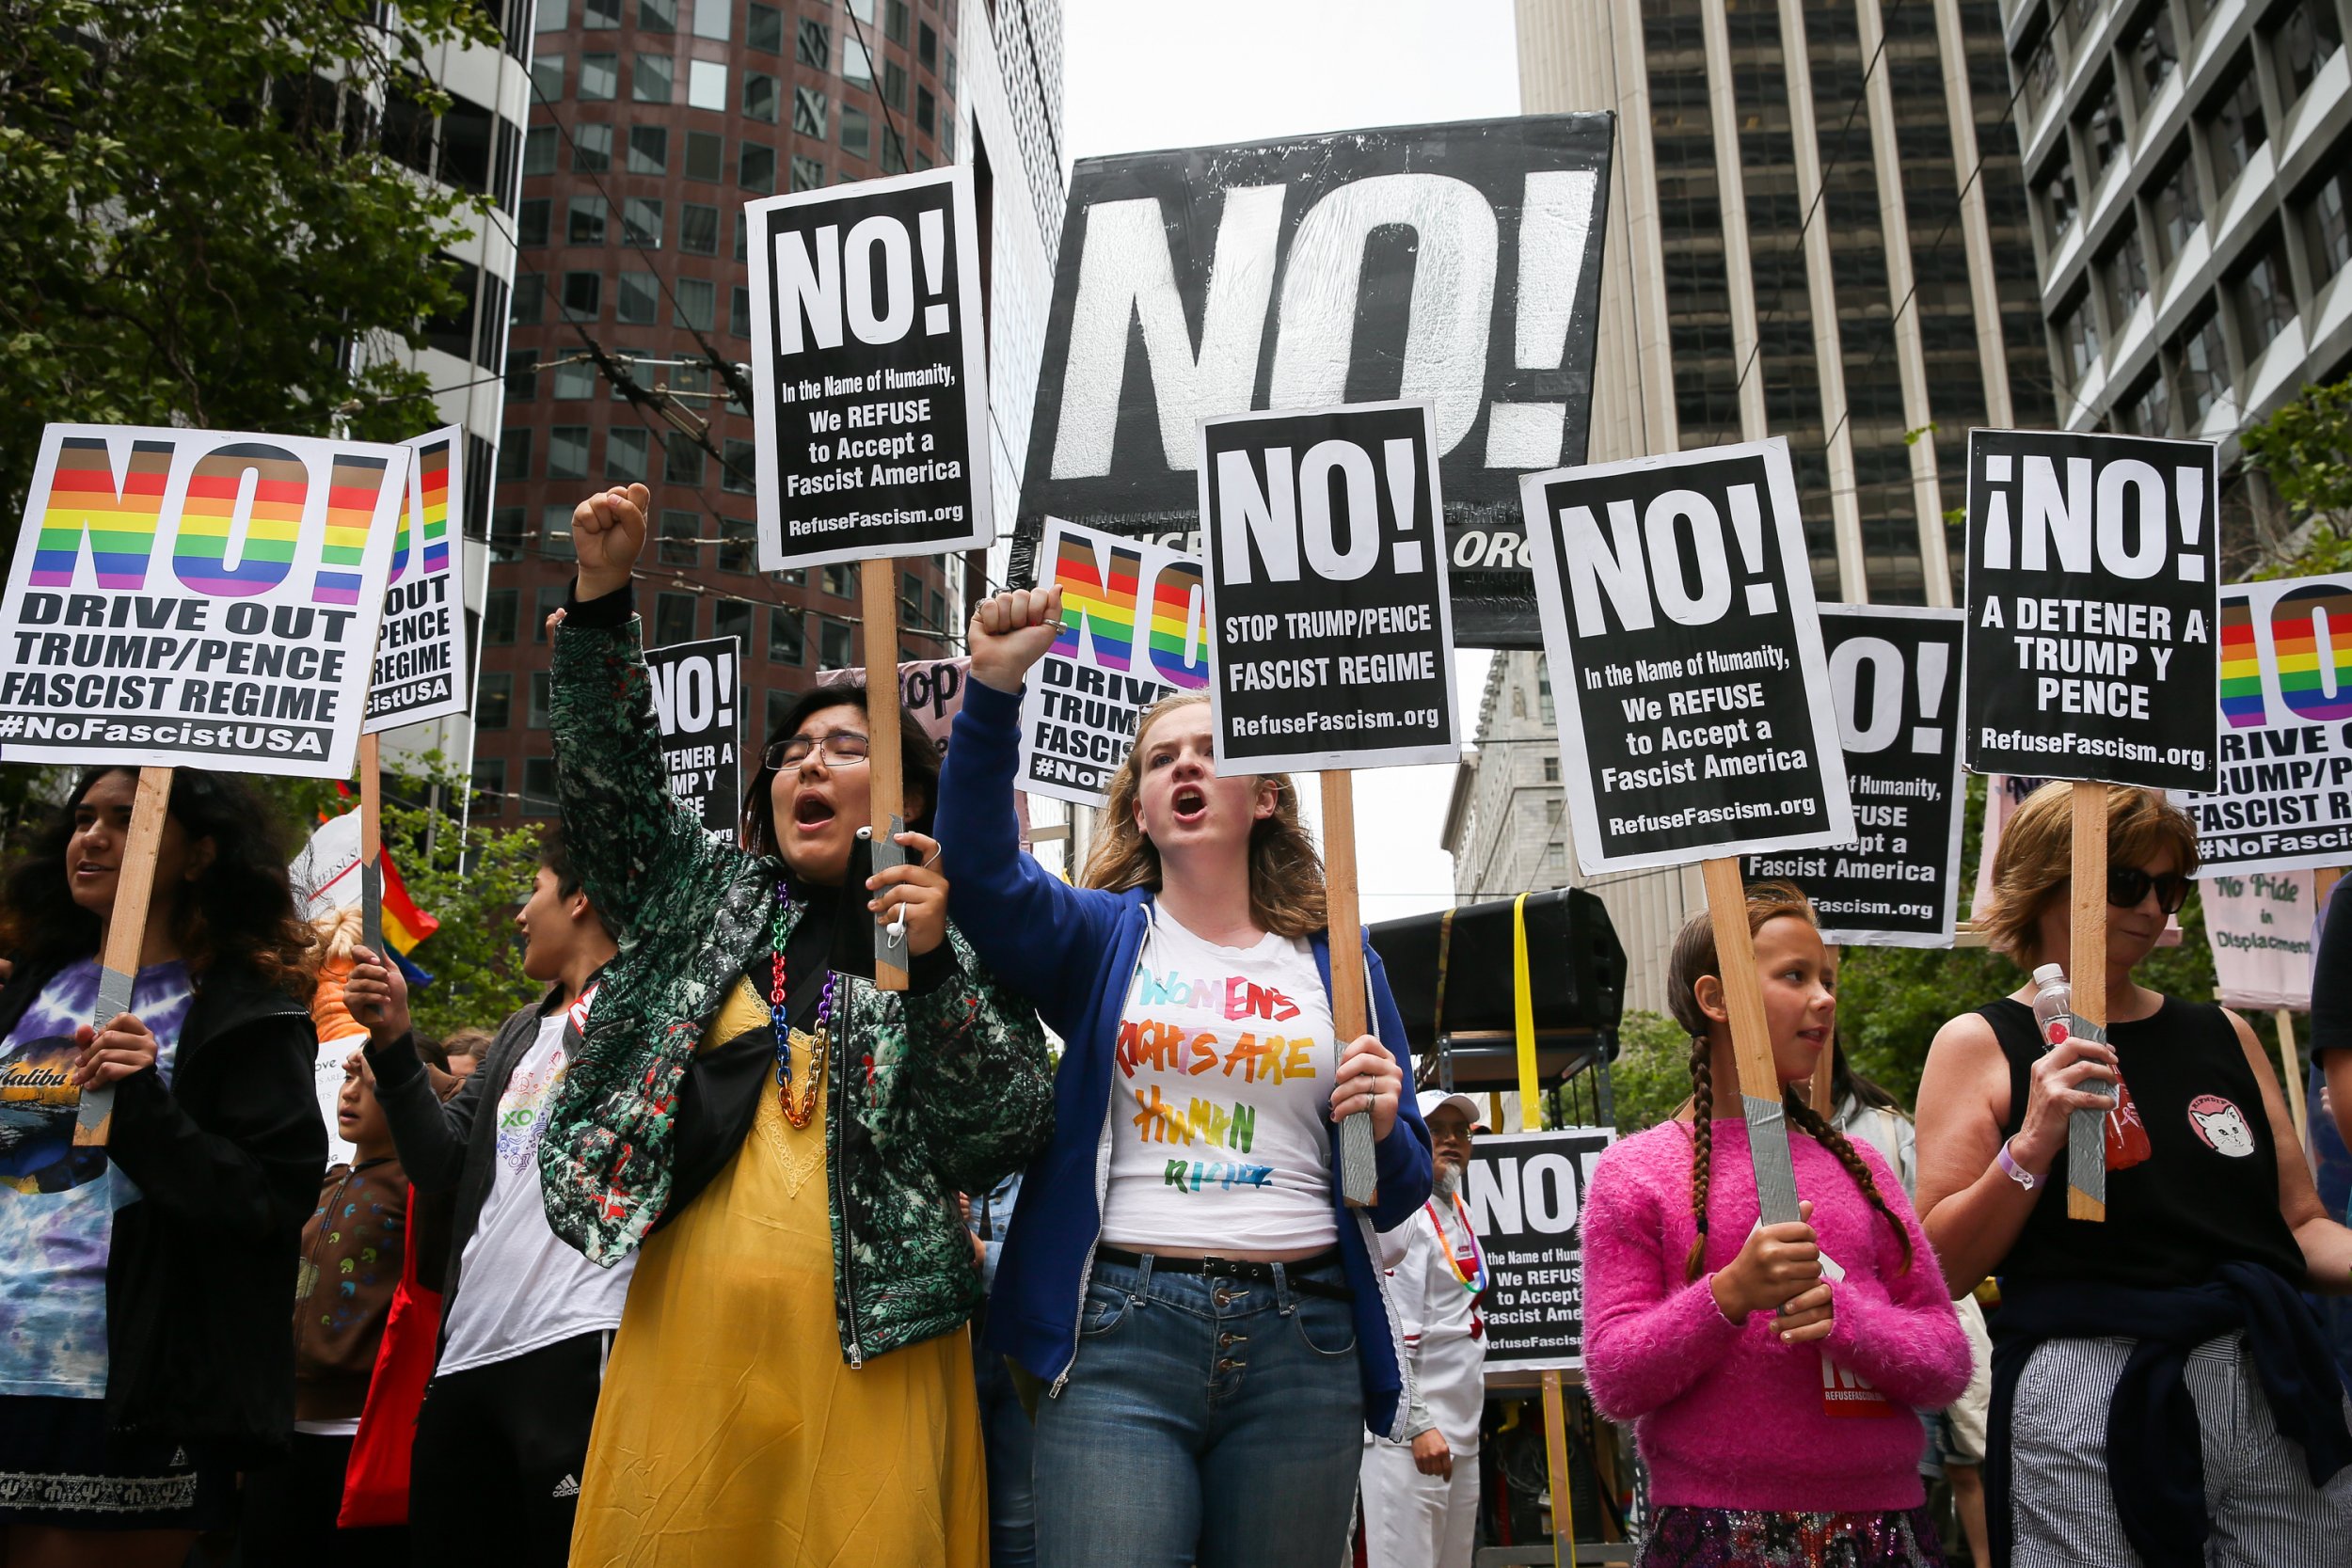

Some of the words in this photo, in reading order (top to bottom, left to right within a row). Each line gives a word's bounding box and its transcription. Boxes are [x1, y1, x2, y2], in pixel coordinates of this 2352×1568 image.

[775, 209, 950, 356] NO!
[1050, 170, 1597, 482] NO!
[782, 382, 796, 403] In
[799, 379, 820, 400] the
[825, 373, 863, 399] Name
[867, 371, 882, 391] of
[886, 363, 956, 389] Humanity,
[809, 410, 841, 434] We
[849, 399, 930, 429] REFUSE
[809, 441, 830, 463] to
[837, 434, 914, 460] Accept
[921, 433, 934, 451] a
[787, 467, 864, 497] Fascist
[871, 459, 961, 487] America
[29, 437, 387, 605] NO!
[789, 504, 963, 536] RefuseFascism.org
[1217, 438, 1423, 585] NO!
[1983, 455, 2204, 582] ¡NO!
[1559, 483, 1777, 638] NO!
[385, 574, 450, 616] OUT
[18, 593, 209, 631] DRIVE
[225, 602, 357, 641] OUT
[377, 607, 450, 652] PENCE
[1226, 614, 1278, 643] STOP
[1285, 605, 1431, 639] TRUMP/PENCE
[1980, 595, 2004, 628] A
[2017, 596, 2171, 641] DETENER
[2183, 610, 2207, 643] A
[13, 631, 345, 683] TRUMP/PENCE
[1230, 658, 1330, 691] FASCIST
[1340, 651, 1435, 685] REGIME
[1584, 667, 1602, 689] In
[1605, 662, 1633, 686] the
[1636, 657, 1683, 684] Name
[1688, 652, 1705, 675] of
[1709, 644, 1789, 673] Humanity,
[2013, 636, 2137, 676] TRUMP
[2151, 647, 2173, 681] Y
[1, 672, 173, 710] FASCIST
[179, 681, 340, 722] REGIME
[366, 679, 449, 713] cistUSA
[649, 653, 733, 736] NO!
[1040, 689, 1137, 736] TRUM
[1621, 697, 1662, 723] We
[1669, 683, 1765, 717] REFUSE
[1828, 637, 1949, 753] O!
[2038, 677, 2149, 720] PENCE
[0, 718, 323, 754] #NoFascistUSA
[1232, 708, 1438, 736] RefuseFascism.org
[1626, 731, 1652, 755] to
[1661, 719, 1750, 752] Accept
[1756, 719, 1772, 739] a
[721, 743, 734, 764] A
[1981, 727, 2204, 770] RefuseFascism.org
[2221, 724, 2328, 763] RIVE
[705, 769, 717, 791] Y
[1601, 758, 1695, 793] Fascist
[1705, 748, 1807, 780] America
[1860, 775, 1941, 800] Humanity,
[1609, 797, 1816, 835] RefuseFascism.org
[1892, 836, 1907, 853] a
[2200, 827, 2352, 860] #NoFasci
[1749, 856, 1826, 877] Fascist
[1835, 859, 1935, 881] America
[2214, 876, 2244, 897] No
[2249, 873, 2298, 902] Pride
[2261, 909, 2273, 924] in
[315, 1059, 337, 1071] ove
[1223, 1032, 1315, 1085] ARE
[1133, 1085, 1256, 1153] HUMAN
[1487, 1251, 1505, 1266] the
[1508, 1249, 1539, 1265] Name
[1541, 1248, 1553, 1263] of
[1496, 1272, 1522, 1287] We
[1528, 1269, 1581, 1285] REFUS
[1497, 1291, 1515, 1306] to
[1519, 1287, 1581, 1304] Accept
[552, 1486, 580, 1497] adida
